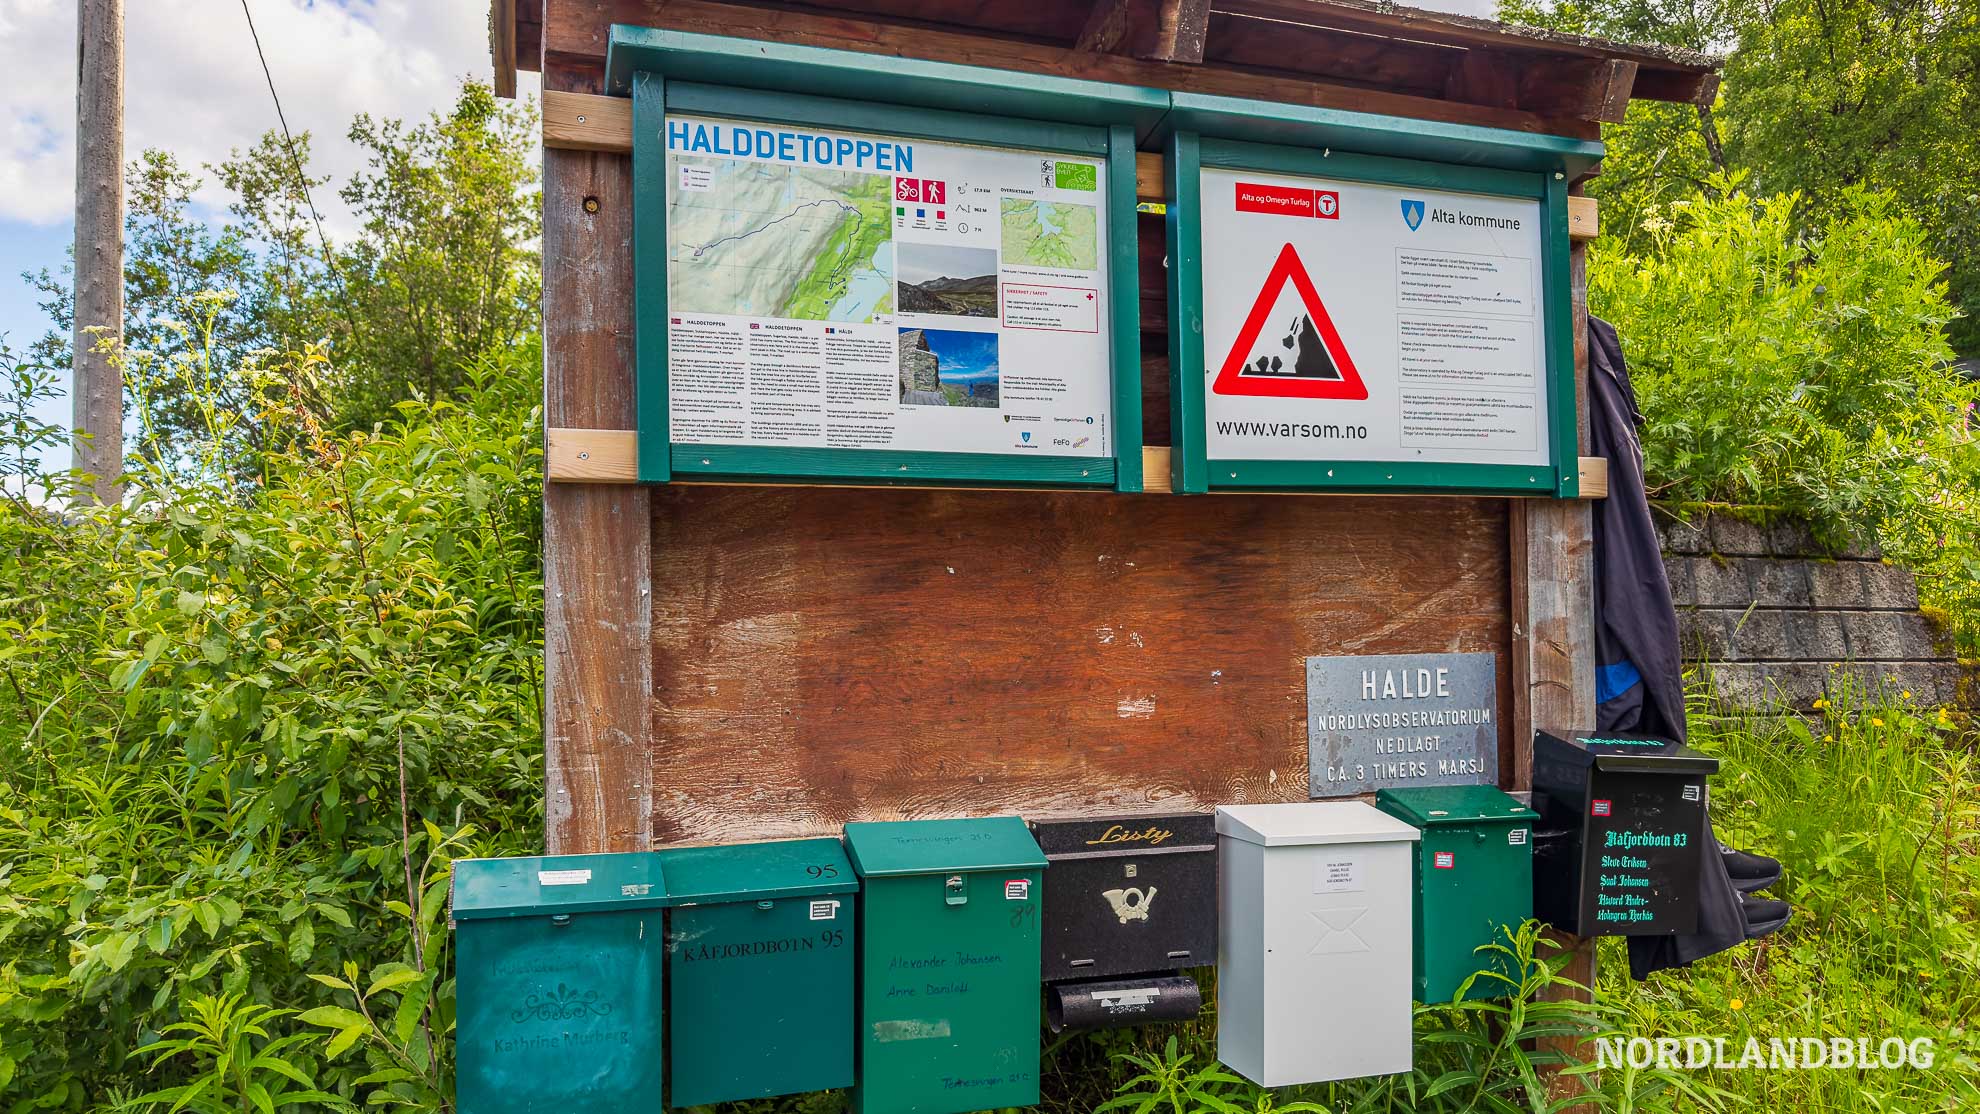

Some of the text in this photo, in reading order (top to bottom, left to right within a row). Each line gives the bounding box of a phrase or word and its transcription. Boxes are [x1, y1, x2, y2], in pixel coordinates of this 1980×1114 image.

[668, 121, 913, 173] HALDDETOPPEN
[1242, 194, 1254, 202] Alta
[1266, 196, 1290, 206] Omegn
[1290, 198, 1310, 208] Turlag
[1431, 208, 1520, 230] Alta kommune
[1216, 421, 1368, 439] www.varsom.no
[1362, 667, 1449, 700] HALDE
[1318, 708, 1491, 731] NORDLYSOBSERVATORIUM
[1376, 736, 1441, 754] NEDLAGT
[1327, 758, 1484, 782] CA. 3 TIMERS MARSJ
[1086, 825, 1174, 845] Listy
[1673, 832, 1687, 846] 83
[806, 864, 839, 879] 95
[822, 930, 843, 948] 95
[494, 1035, 559, 1053] Kathrine
